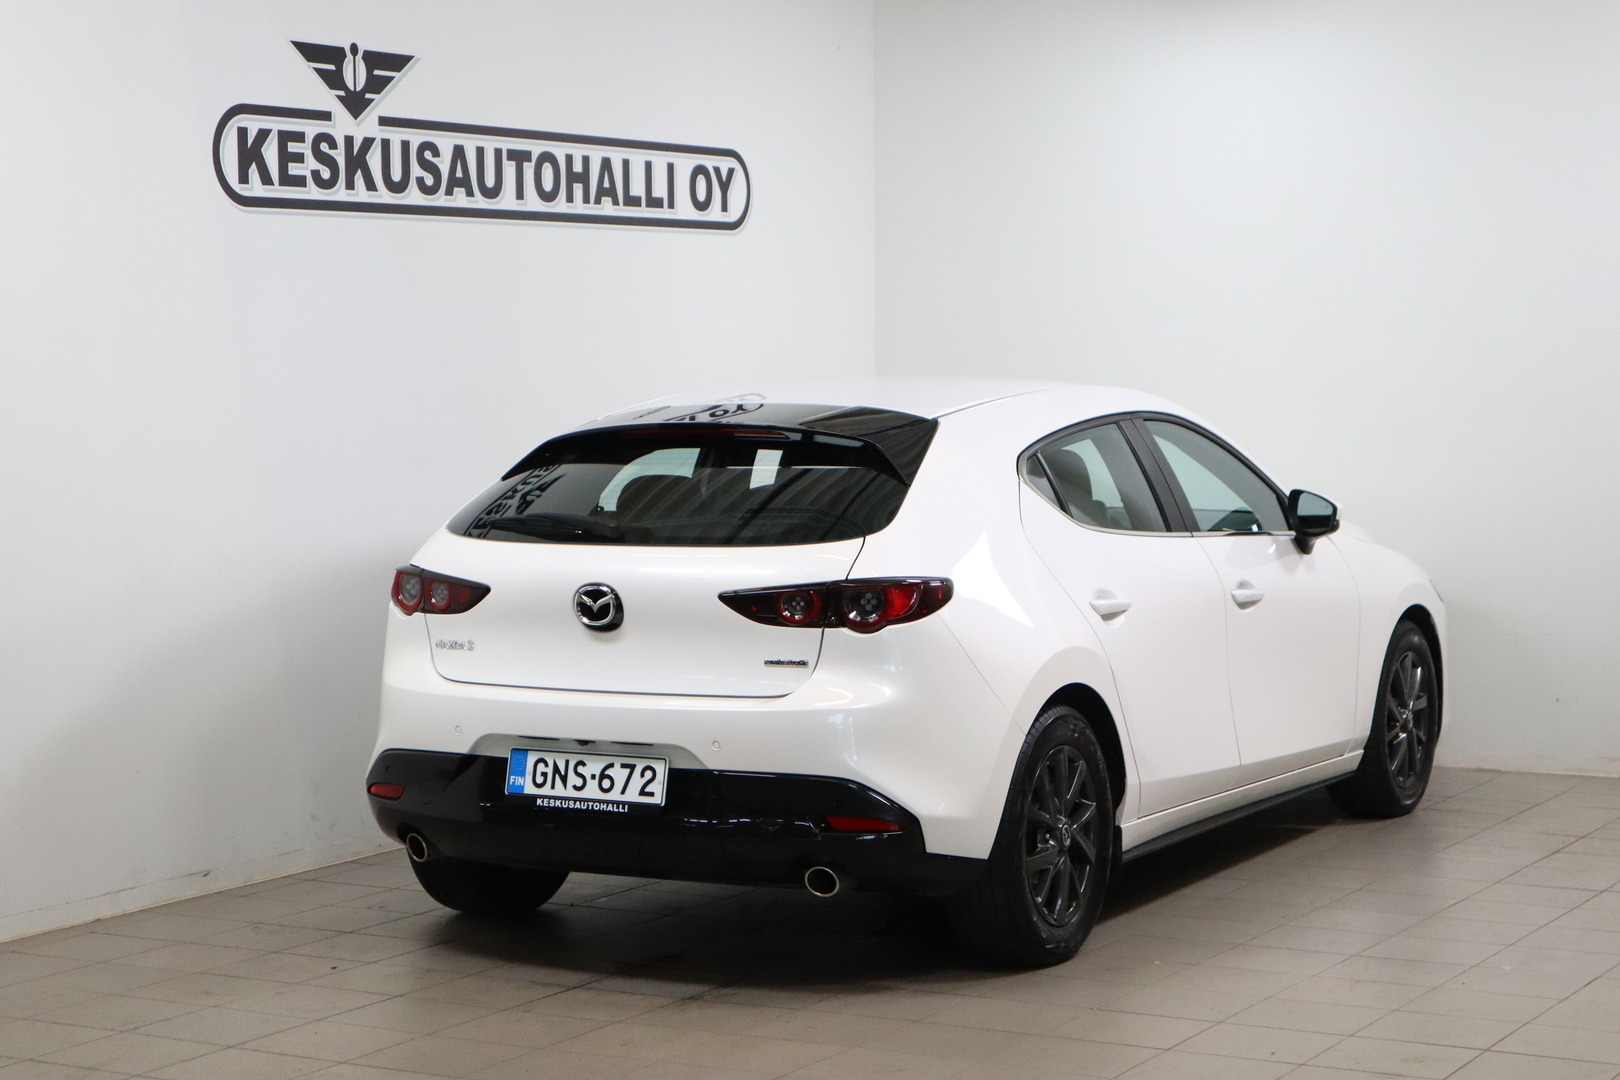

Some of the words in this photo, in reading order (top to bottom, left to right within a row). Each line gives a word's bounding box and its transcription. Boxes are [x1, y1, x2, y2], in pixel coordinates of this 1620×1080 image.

[236, 126, 675, 210] KESKUSAUTOHALLI
[688, 164, 736, 214] OY
[509, 775, 525, 786] FIN
[536, 798, 628, 812] KESKUSAUTOHALLI
